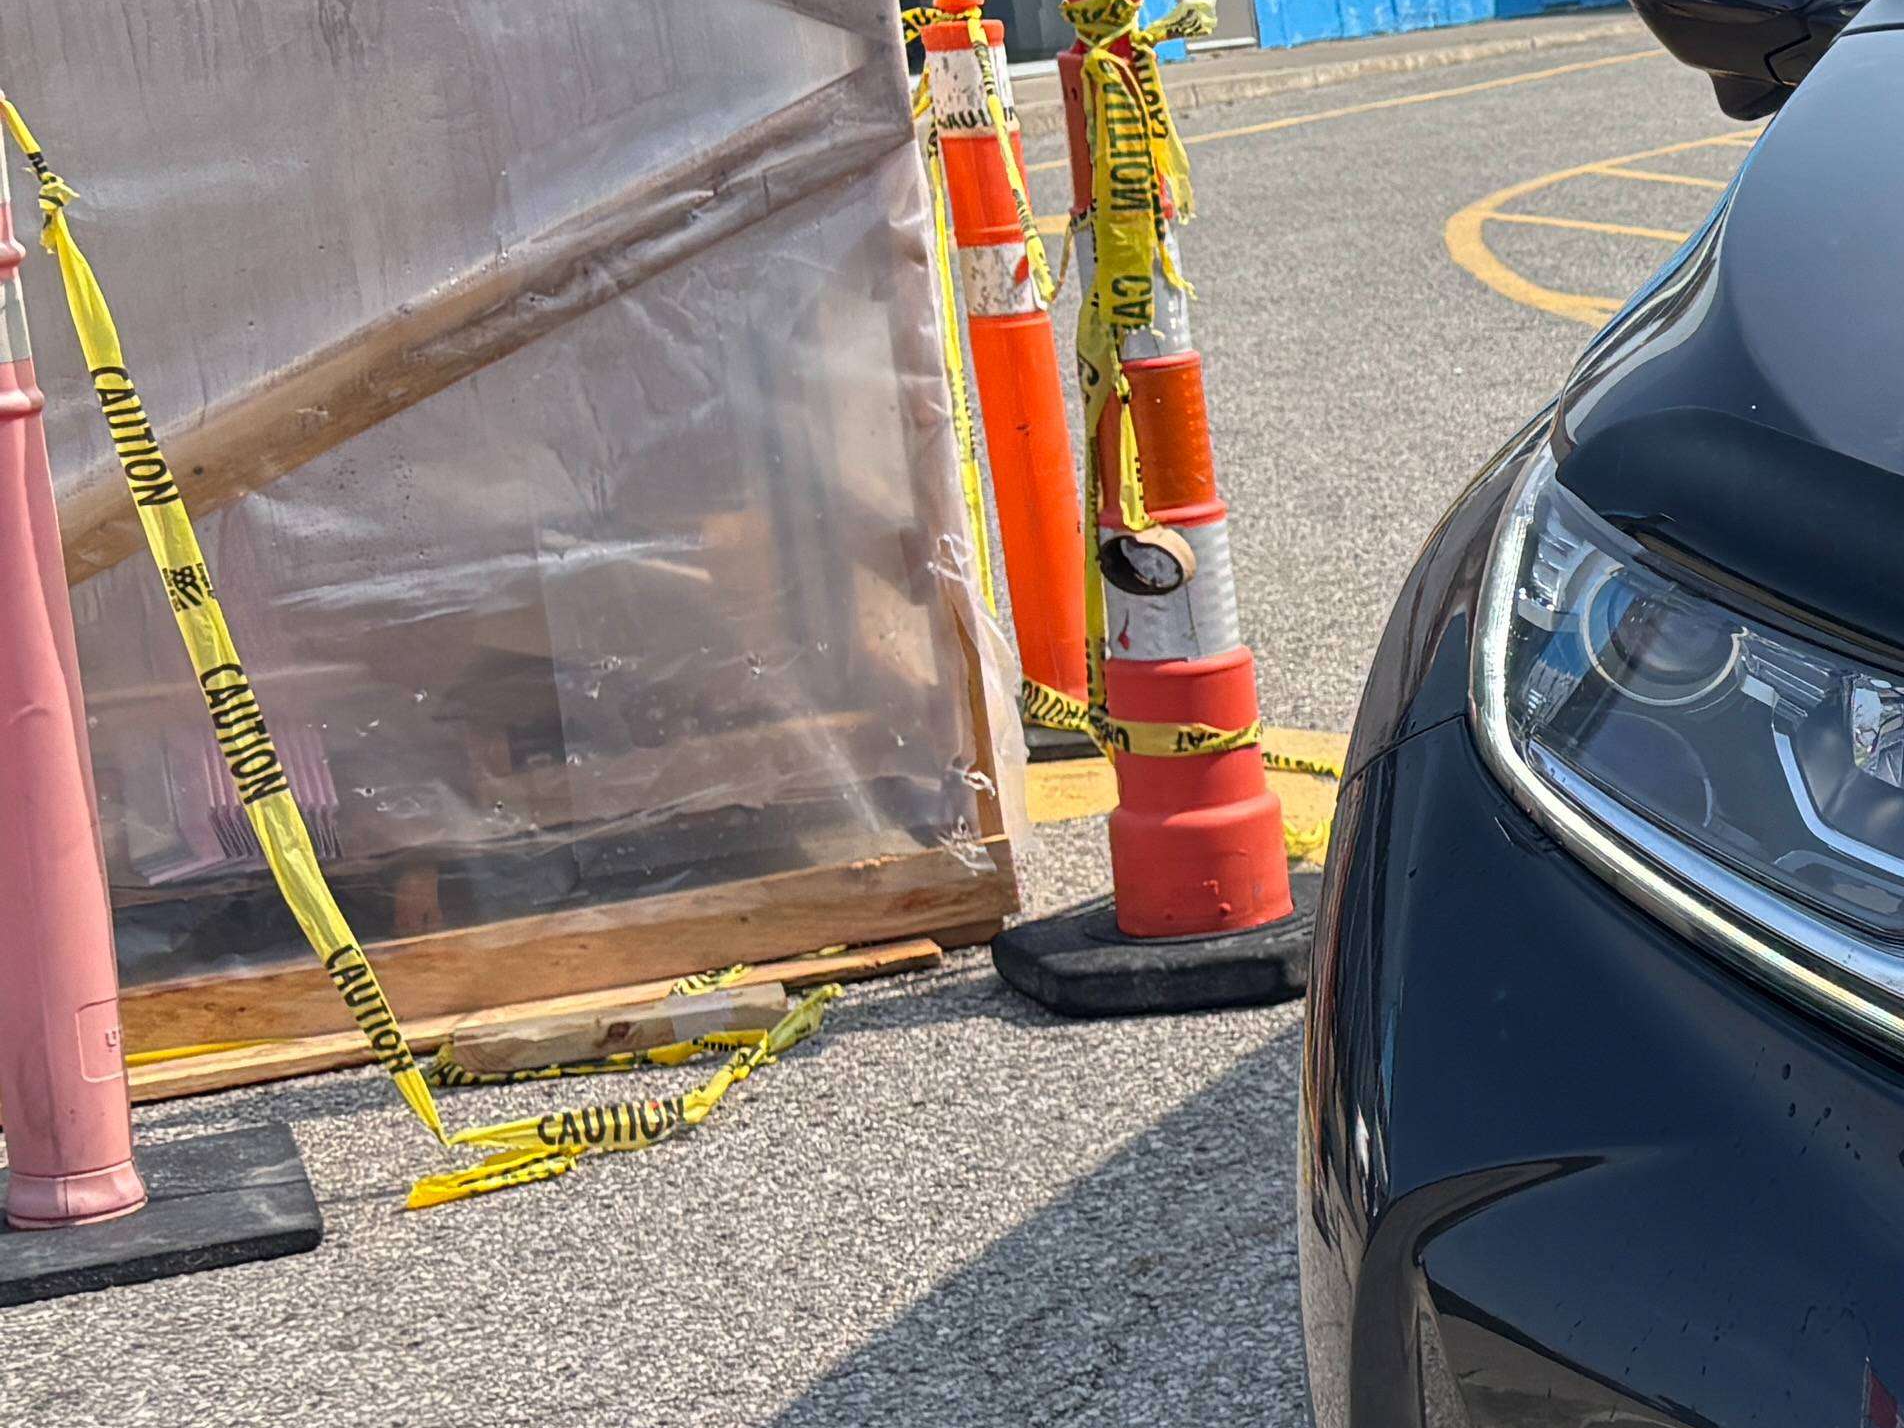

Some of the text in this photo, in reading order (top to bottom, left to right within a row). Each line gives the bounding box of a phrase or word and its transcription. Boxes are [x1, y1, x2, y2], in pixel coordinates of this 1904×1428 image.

[91, 366, 181, 507] CAUTION
[200, 663, 289, 805] CAUTION
[324, 944, 417, 1075] CAUTION
[537, 1096, 684, 1147] CAUTION
